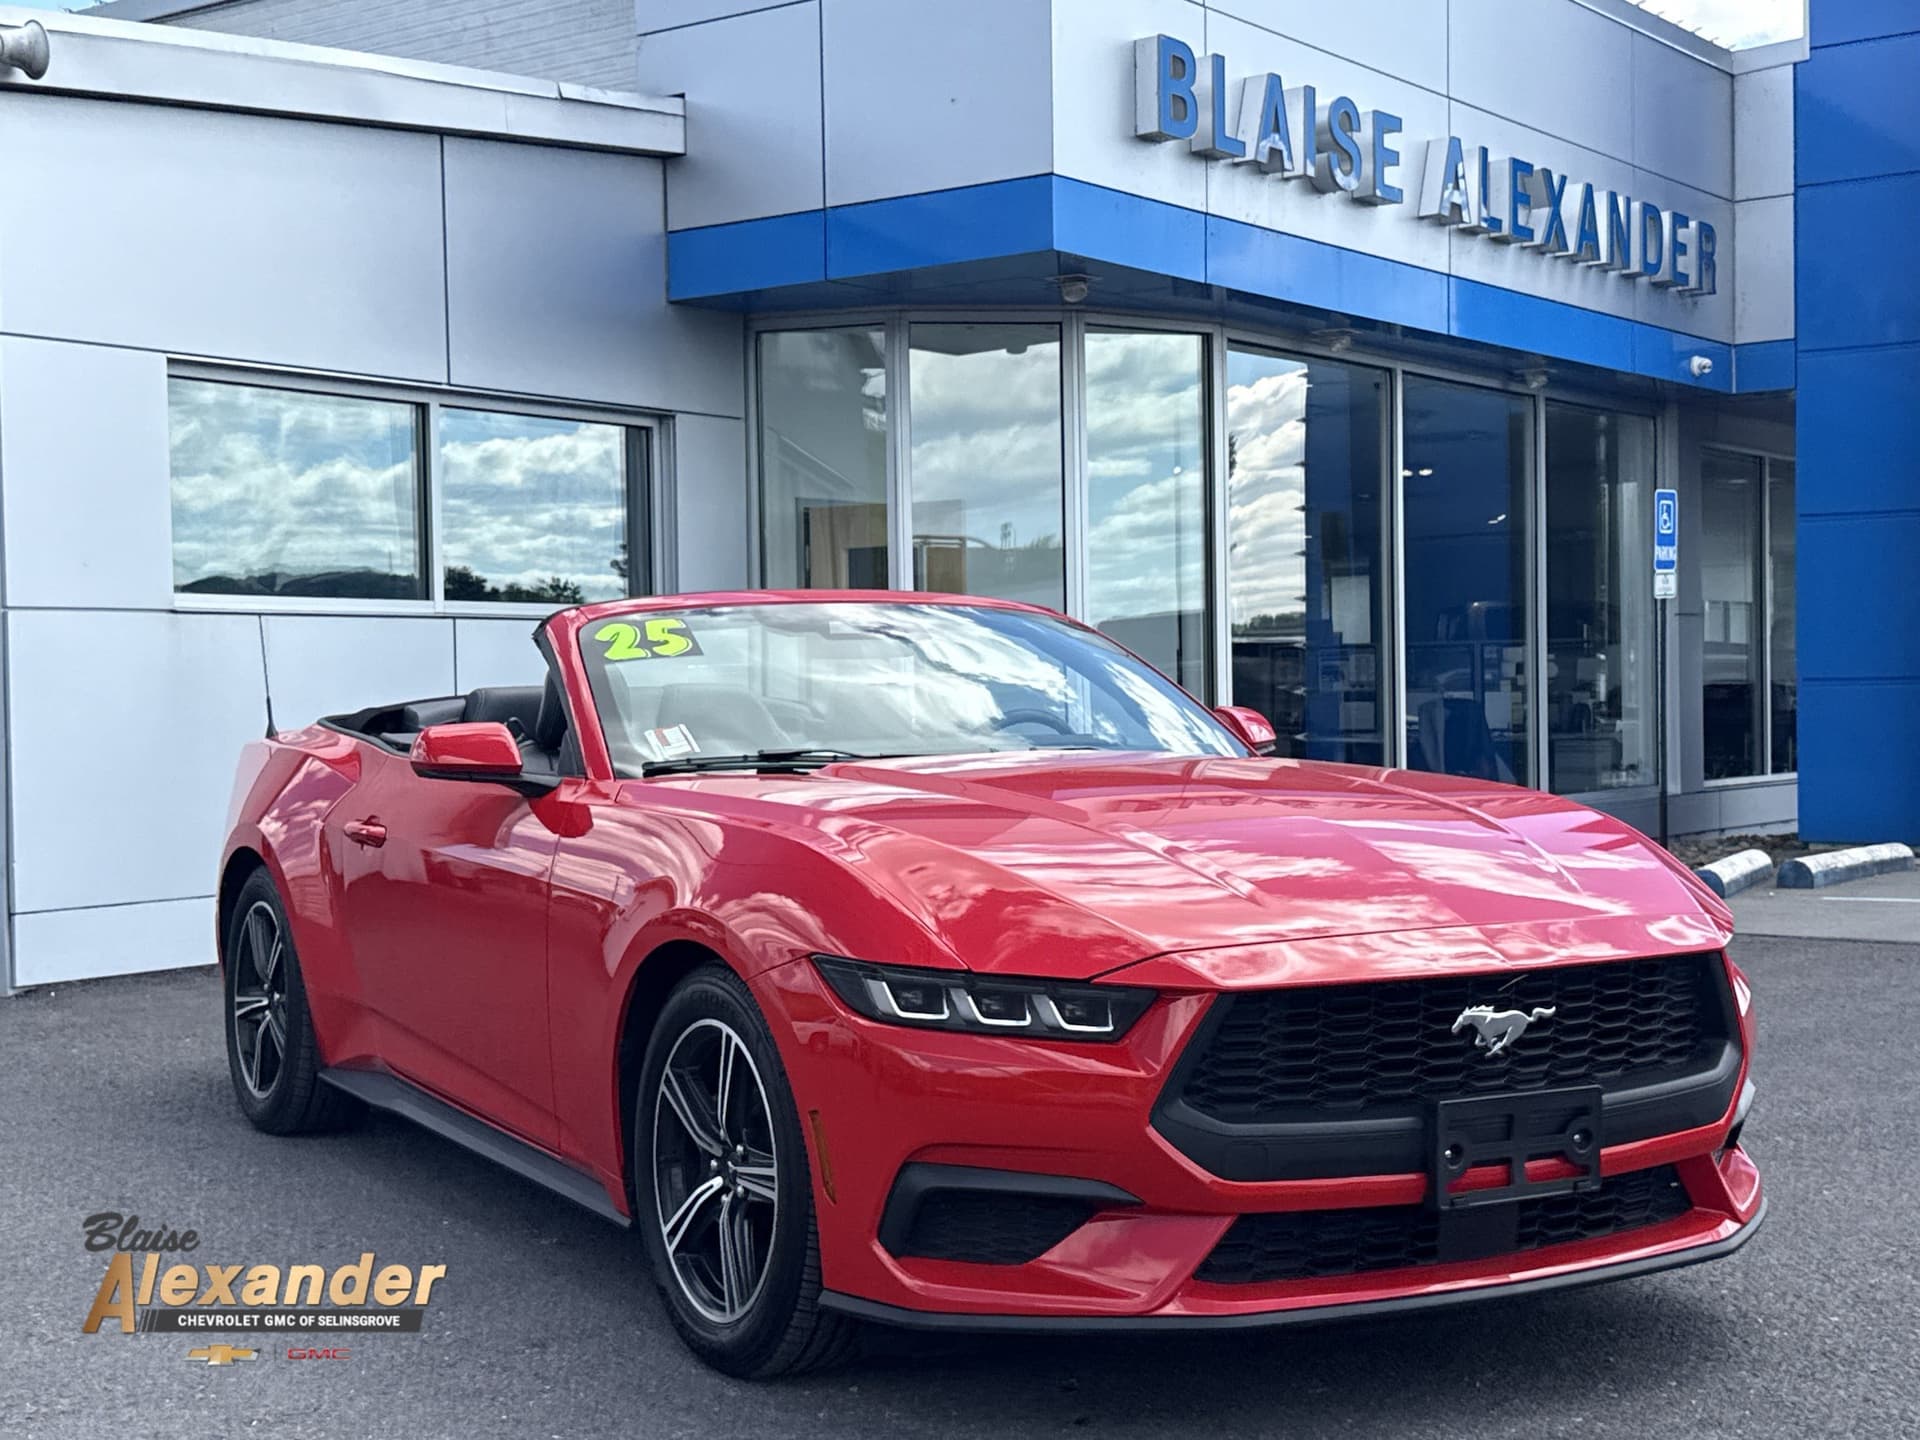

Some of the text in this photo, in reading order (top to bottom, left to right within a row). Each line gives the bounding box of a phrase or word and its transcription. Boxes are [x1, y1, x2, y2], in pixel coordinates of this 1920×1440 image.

[1136, 34, 1717, 296] BLAISE ALEXANDER
[594, 618, 693, 661] 25
